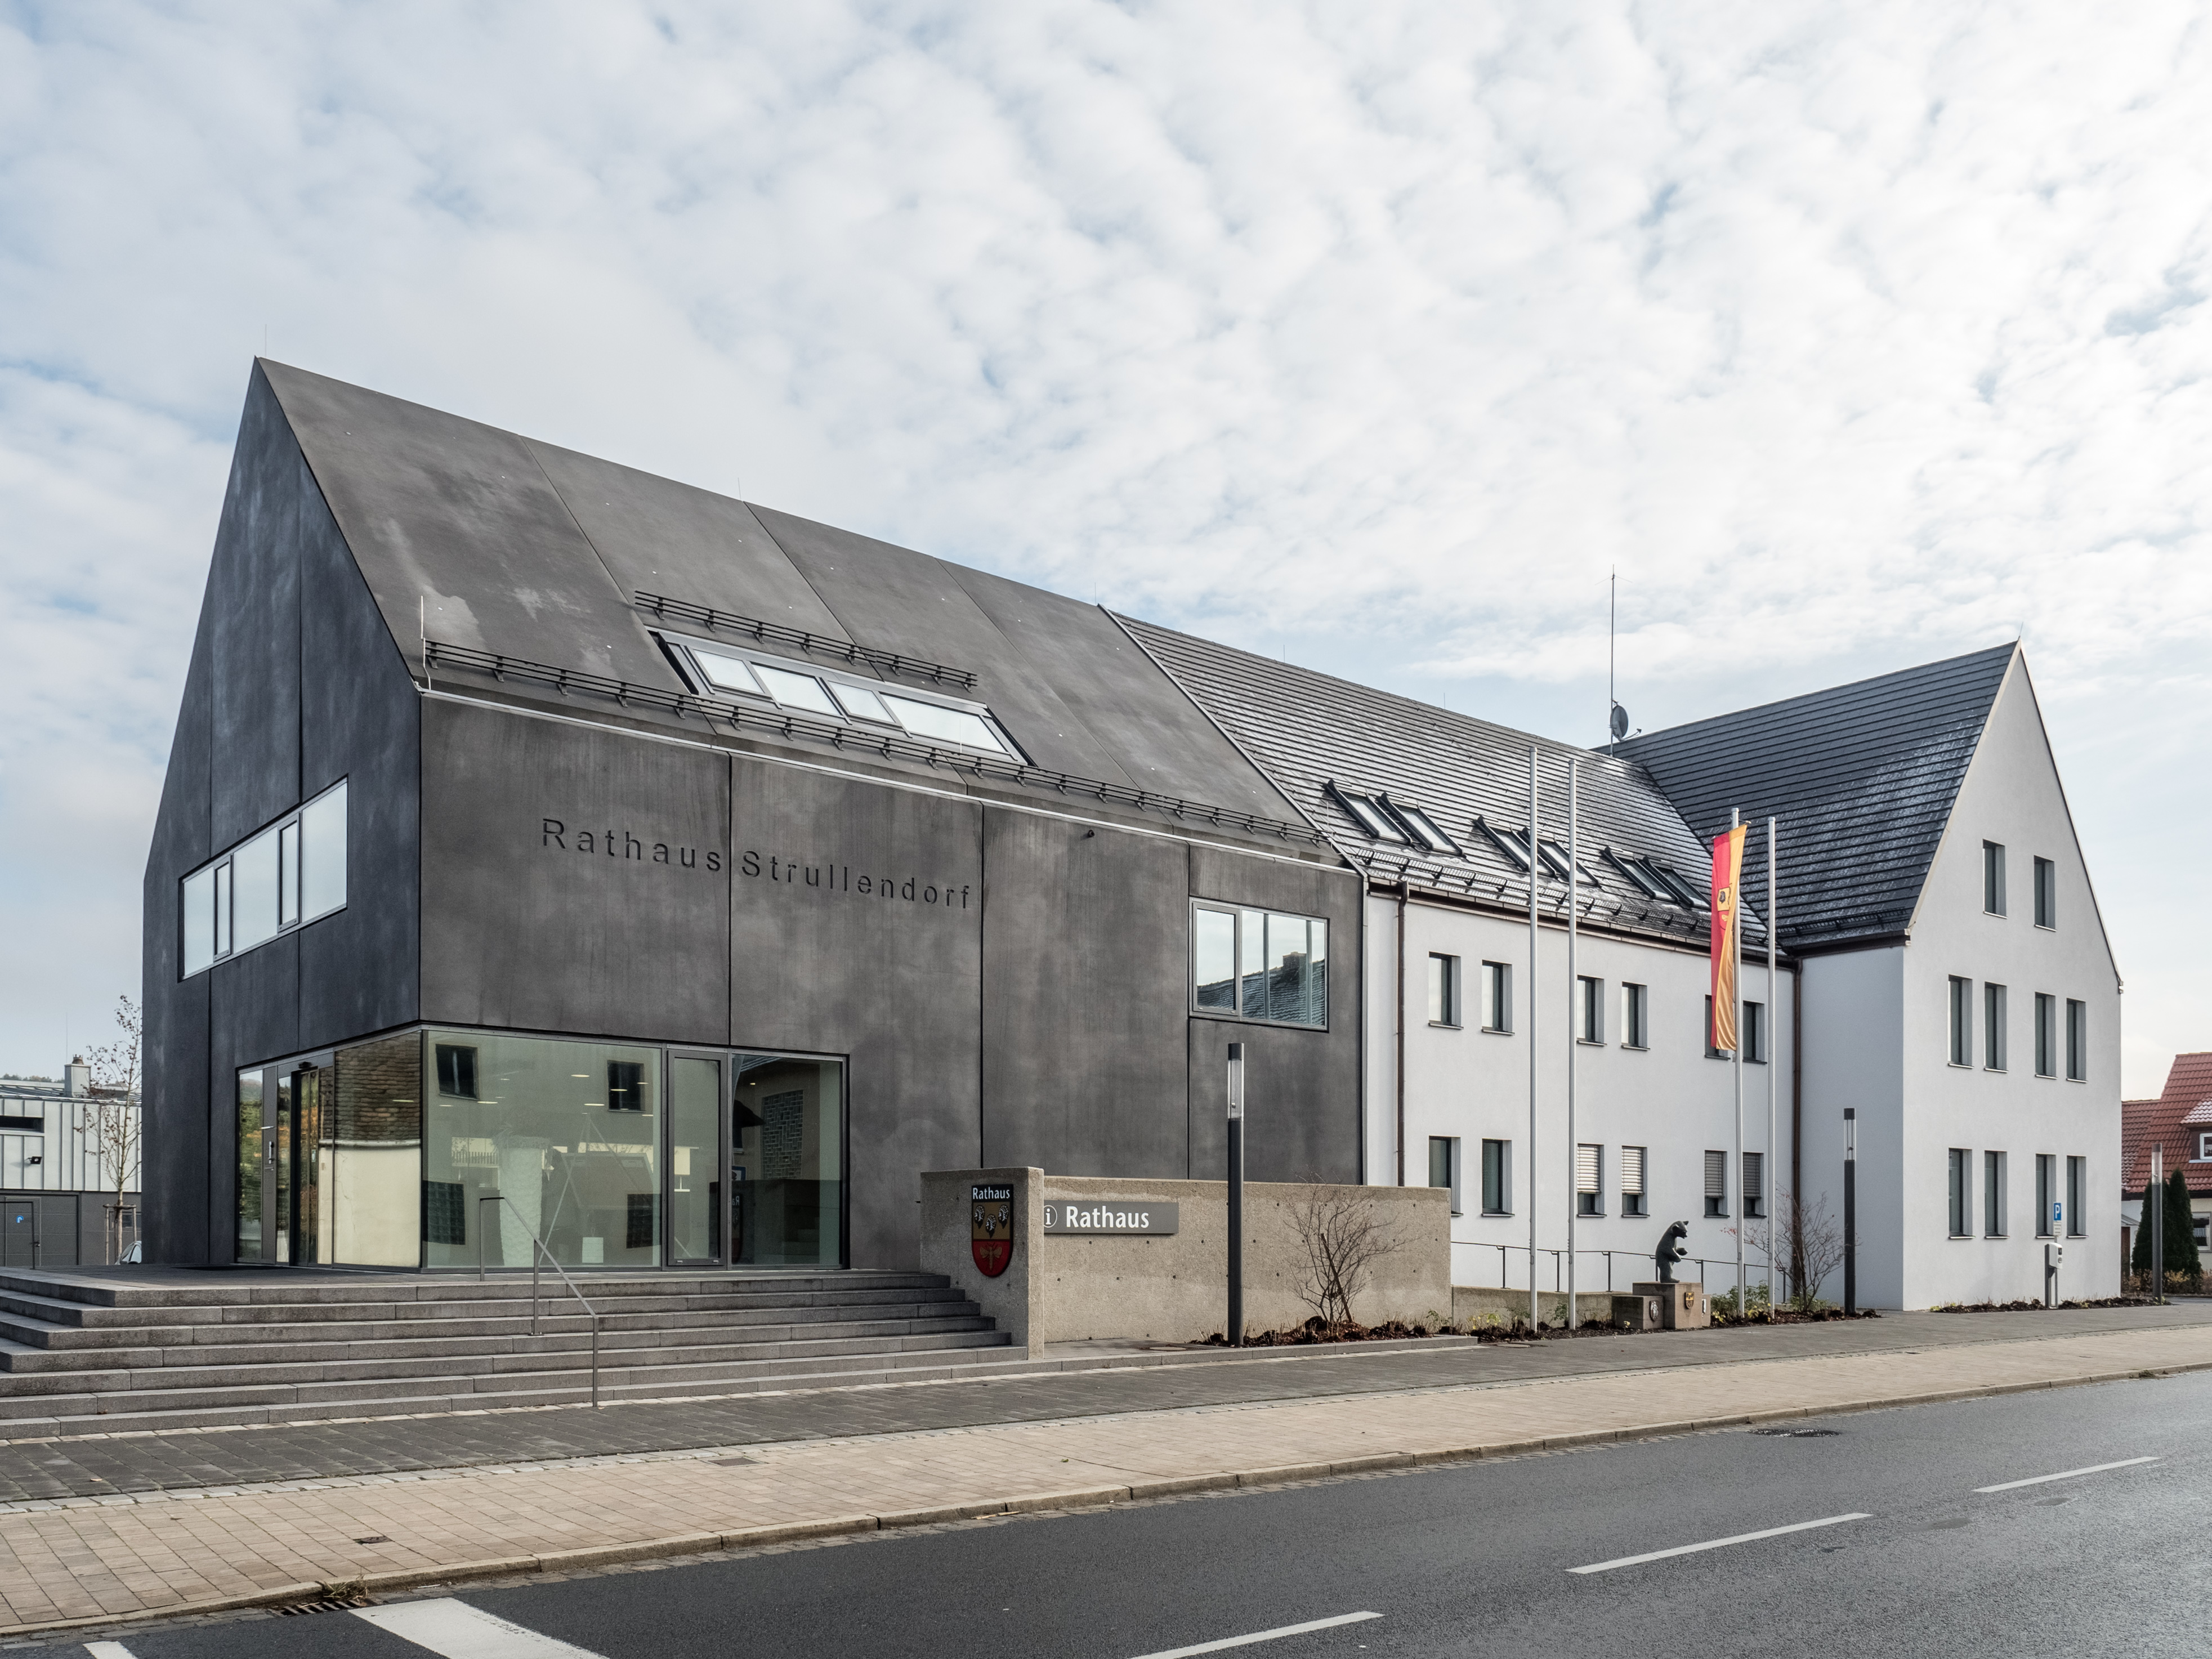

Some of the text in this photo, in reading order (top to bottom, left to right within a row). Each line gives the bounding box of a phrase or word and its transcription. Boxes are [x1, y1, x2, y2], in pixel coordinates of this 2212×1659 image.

[543, 819, 969, 909] Rathaus Strullendorf
[973, 1186, 1010, 1200] Rathaus
[1066, 1205, 1150, 1228] Rathaus
[2055, 1205, 2061, 1219] P
